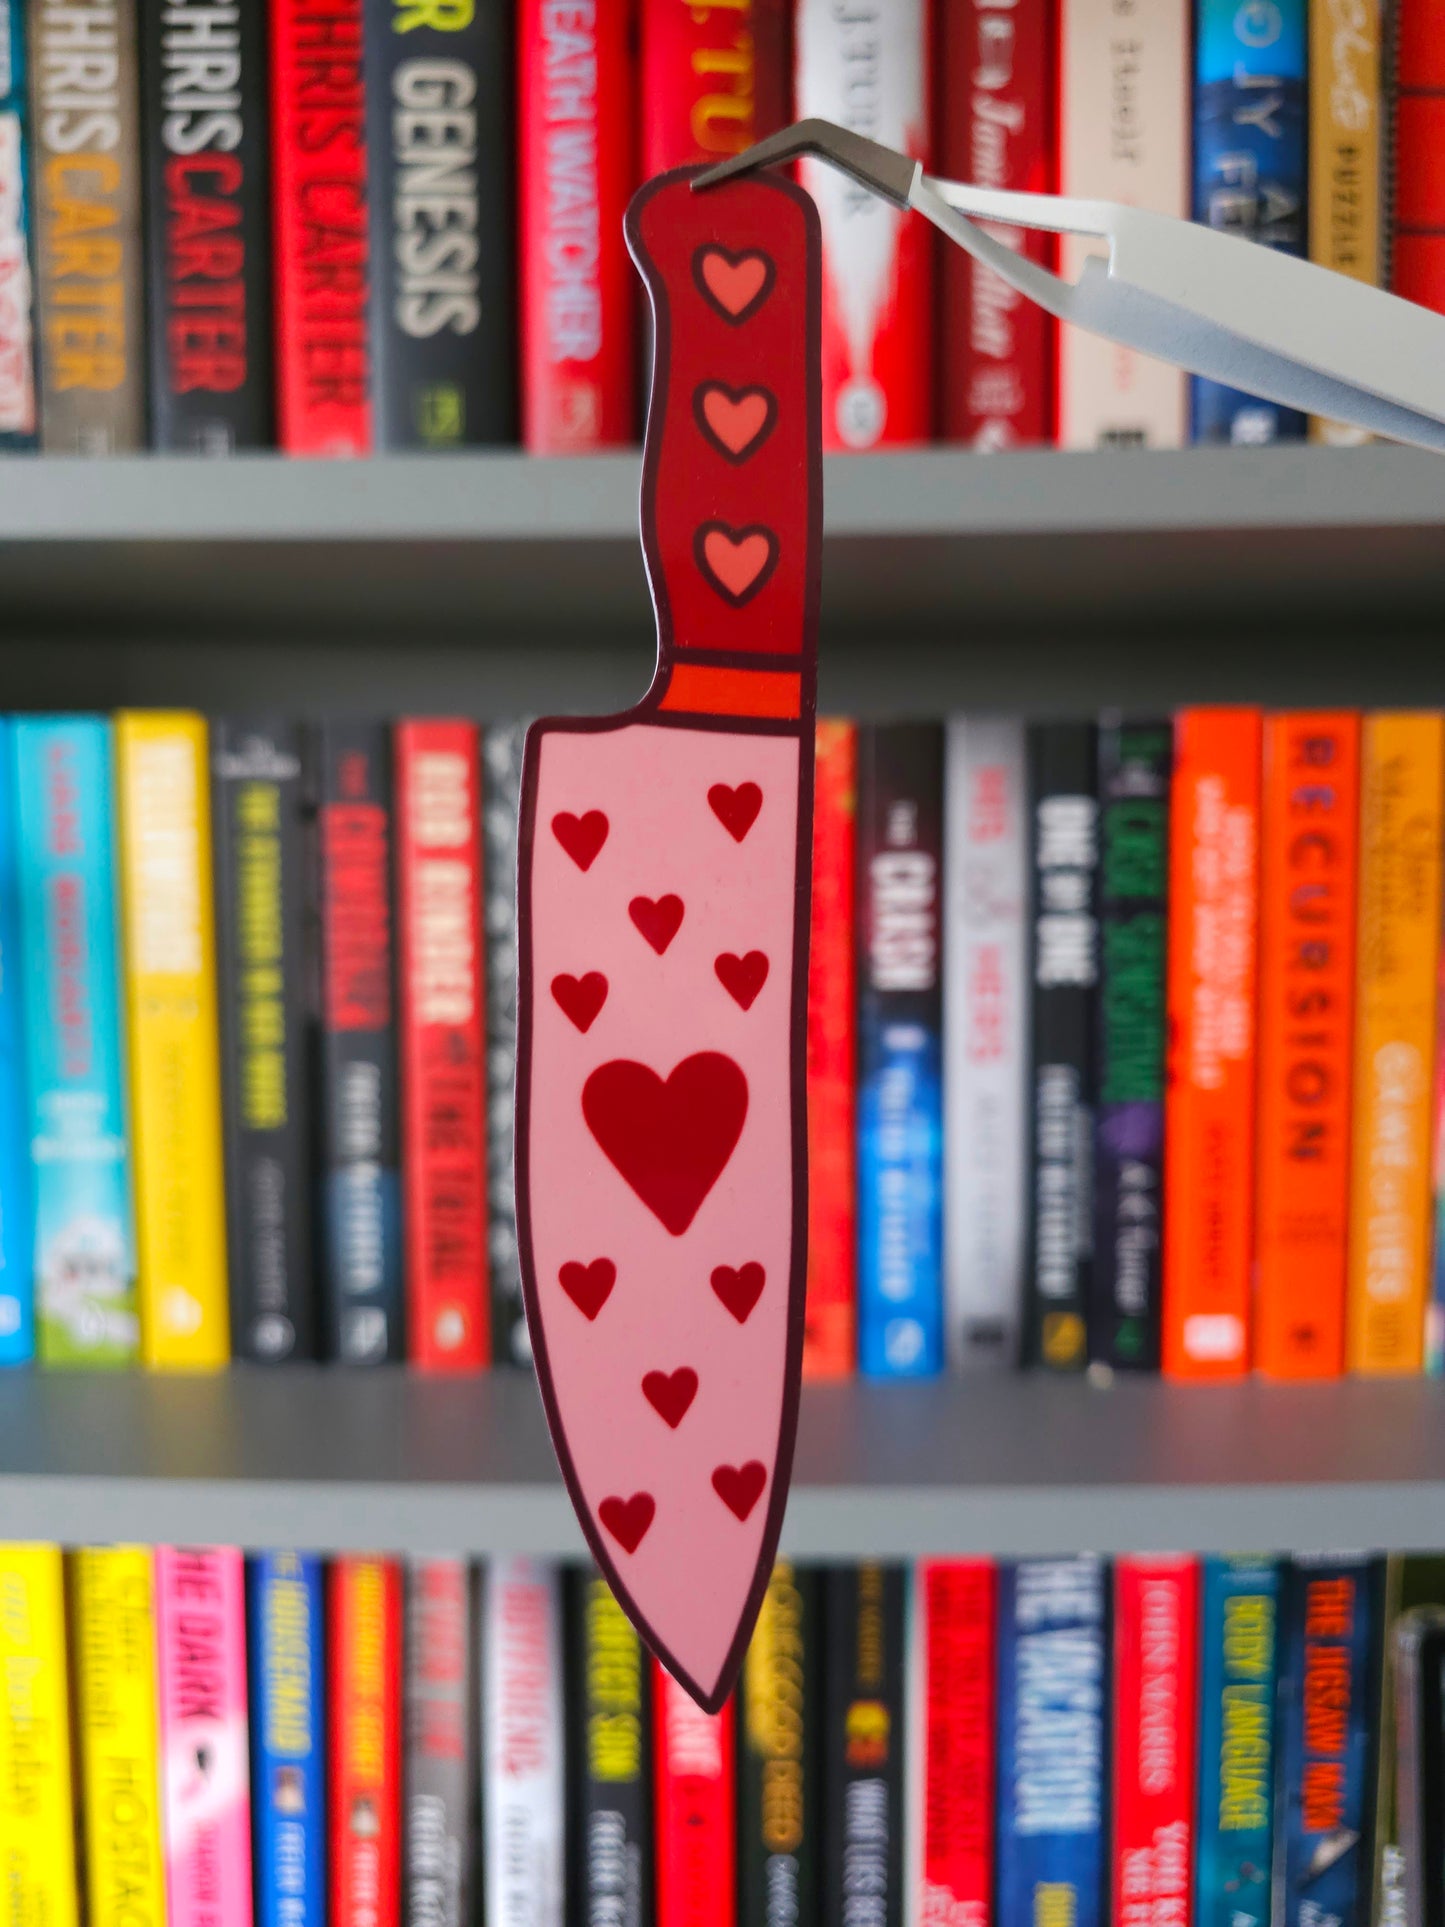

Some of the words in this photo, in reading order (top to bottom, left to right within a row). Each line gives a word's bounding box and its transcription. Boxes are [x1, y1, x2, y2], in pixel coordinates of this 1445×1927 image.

[41, 0, 120, 153] HRIS
[162, 0, 243, 154] HRIS
[43, 152, 127, 393] CARTER
[165, 153, 247, 394] CARTER
[391, 57, 480, 339] GENESIS
[546, 126, 603, 364] WATCHER
[300, 177, 370, 408] CARTER
[871, 851, 935, 992] CRASH
[1287, 734, 1337, 1163] RECURSION
[171, 1612, 227, 1722] DARK
[1223, 1595, 1277, 1678] BODY
[1304, 1575, 1357, 1638] THE
[1014, 1626, 1103, 1836] VACATION
[1218, 1684, 1272, 1832] LANGUAGE
[1303, 1645, 1352, 1757] JIGSAW
[1302, 1762, 1347, 1835] MAN
